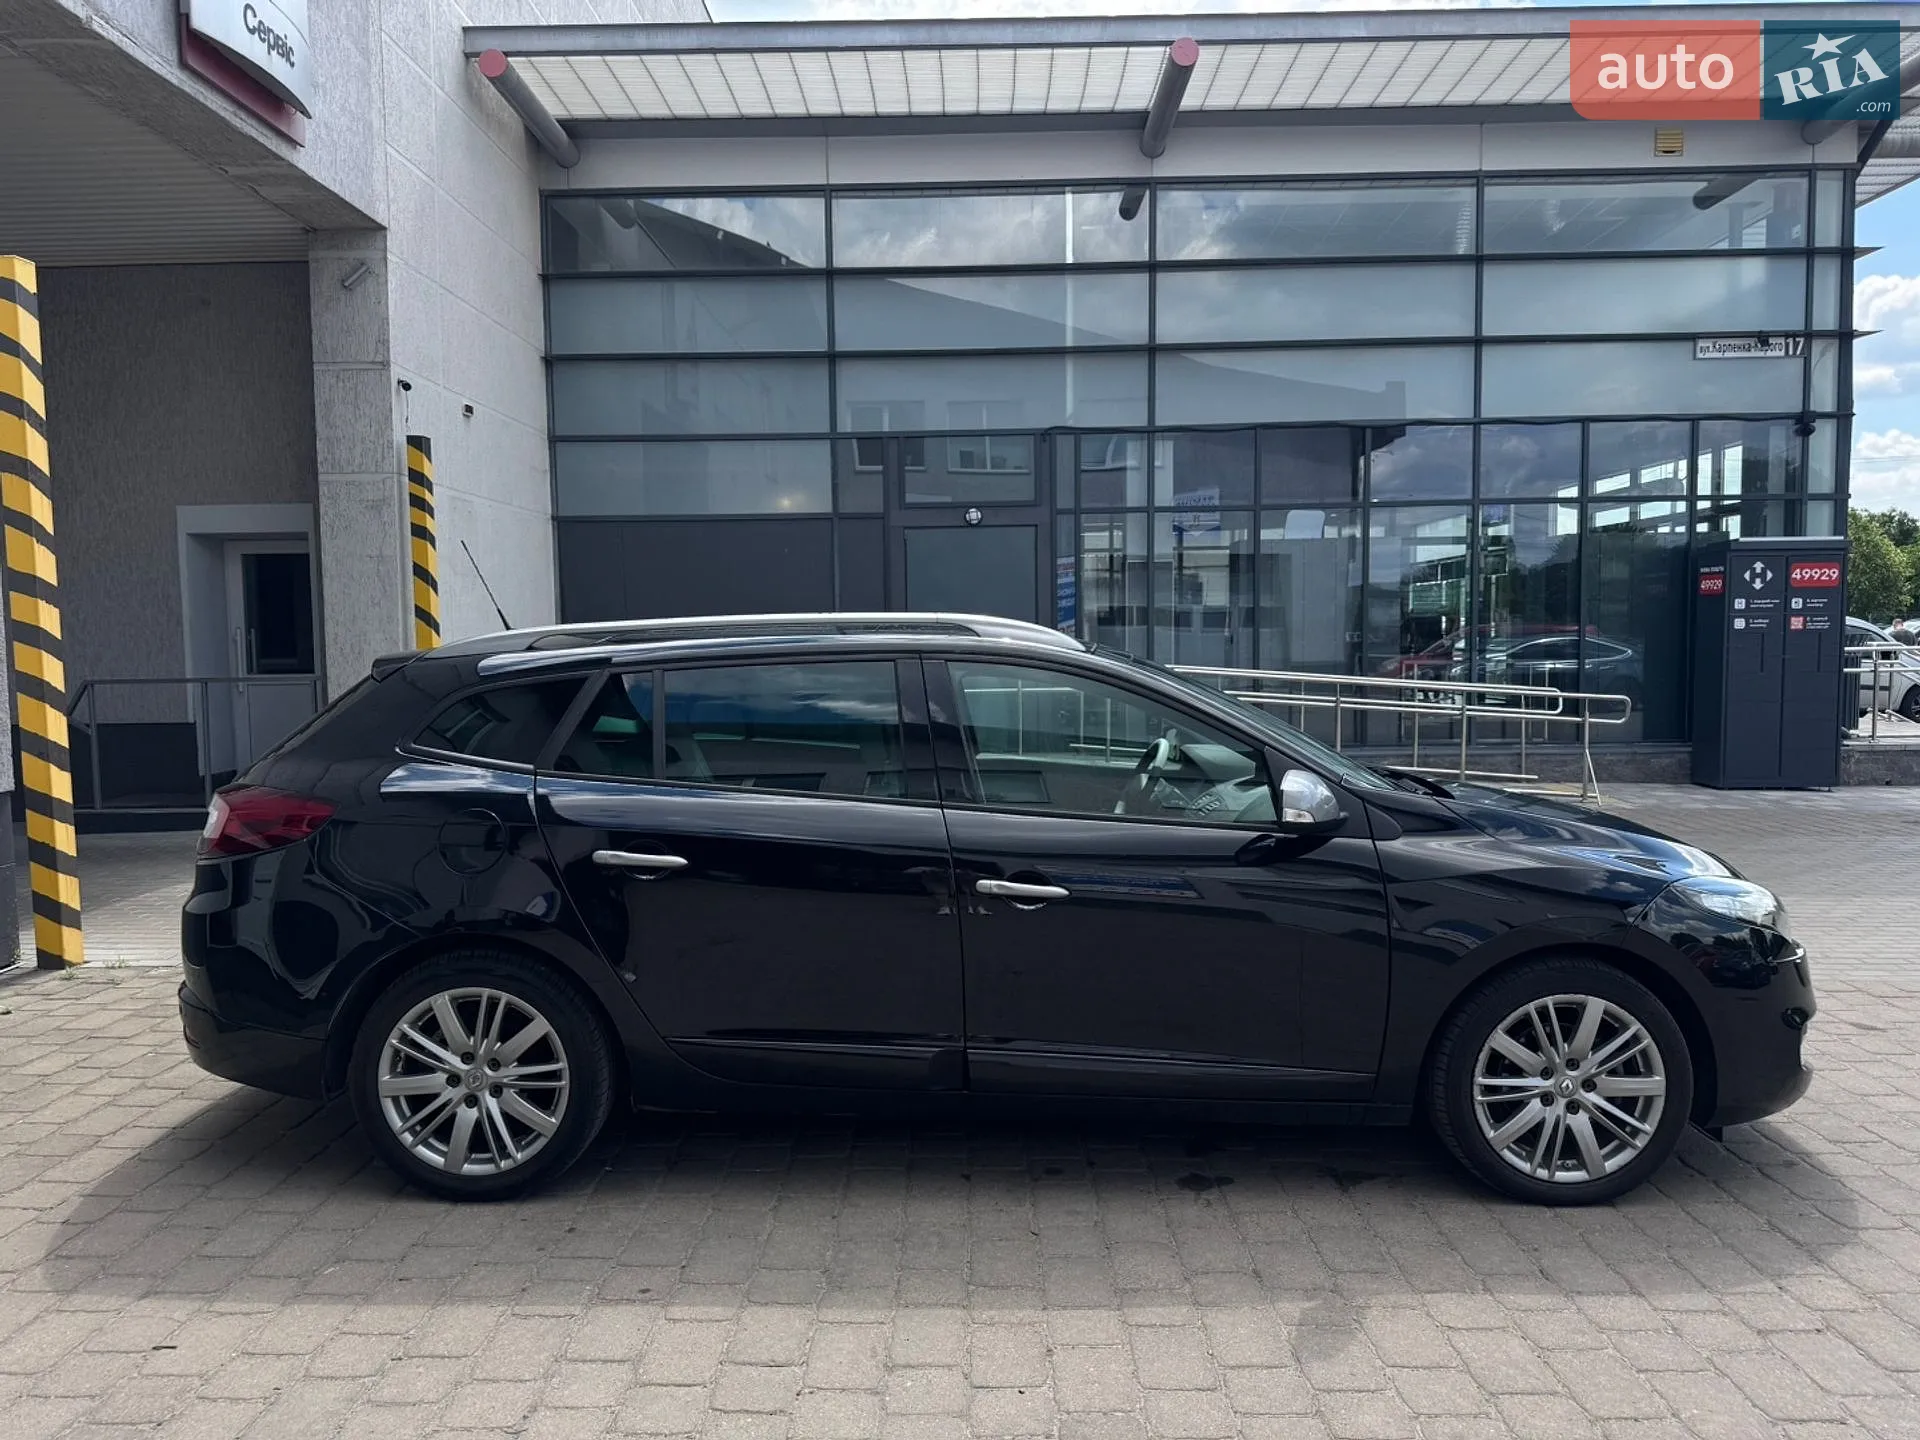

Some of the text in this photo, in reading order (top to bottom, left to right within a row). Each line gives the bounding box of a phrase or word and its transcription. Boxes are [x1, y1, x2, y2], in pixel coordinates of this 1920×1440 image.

[243, 3, 295, 68] Сервіс
[1786, 337, 1805, 356] 17
[1791, 568, 1839, 581] 49929
[1700, 579, 1723, 590] 49929
